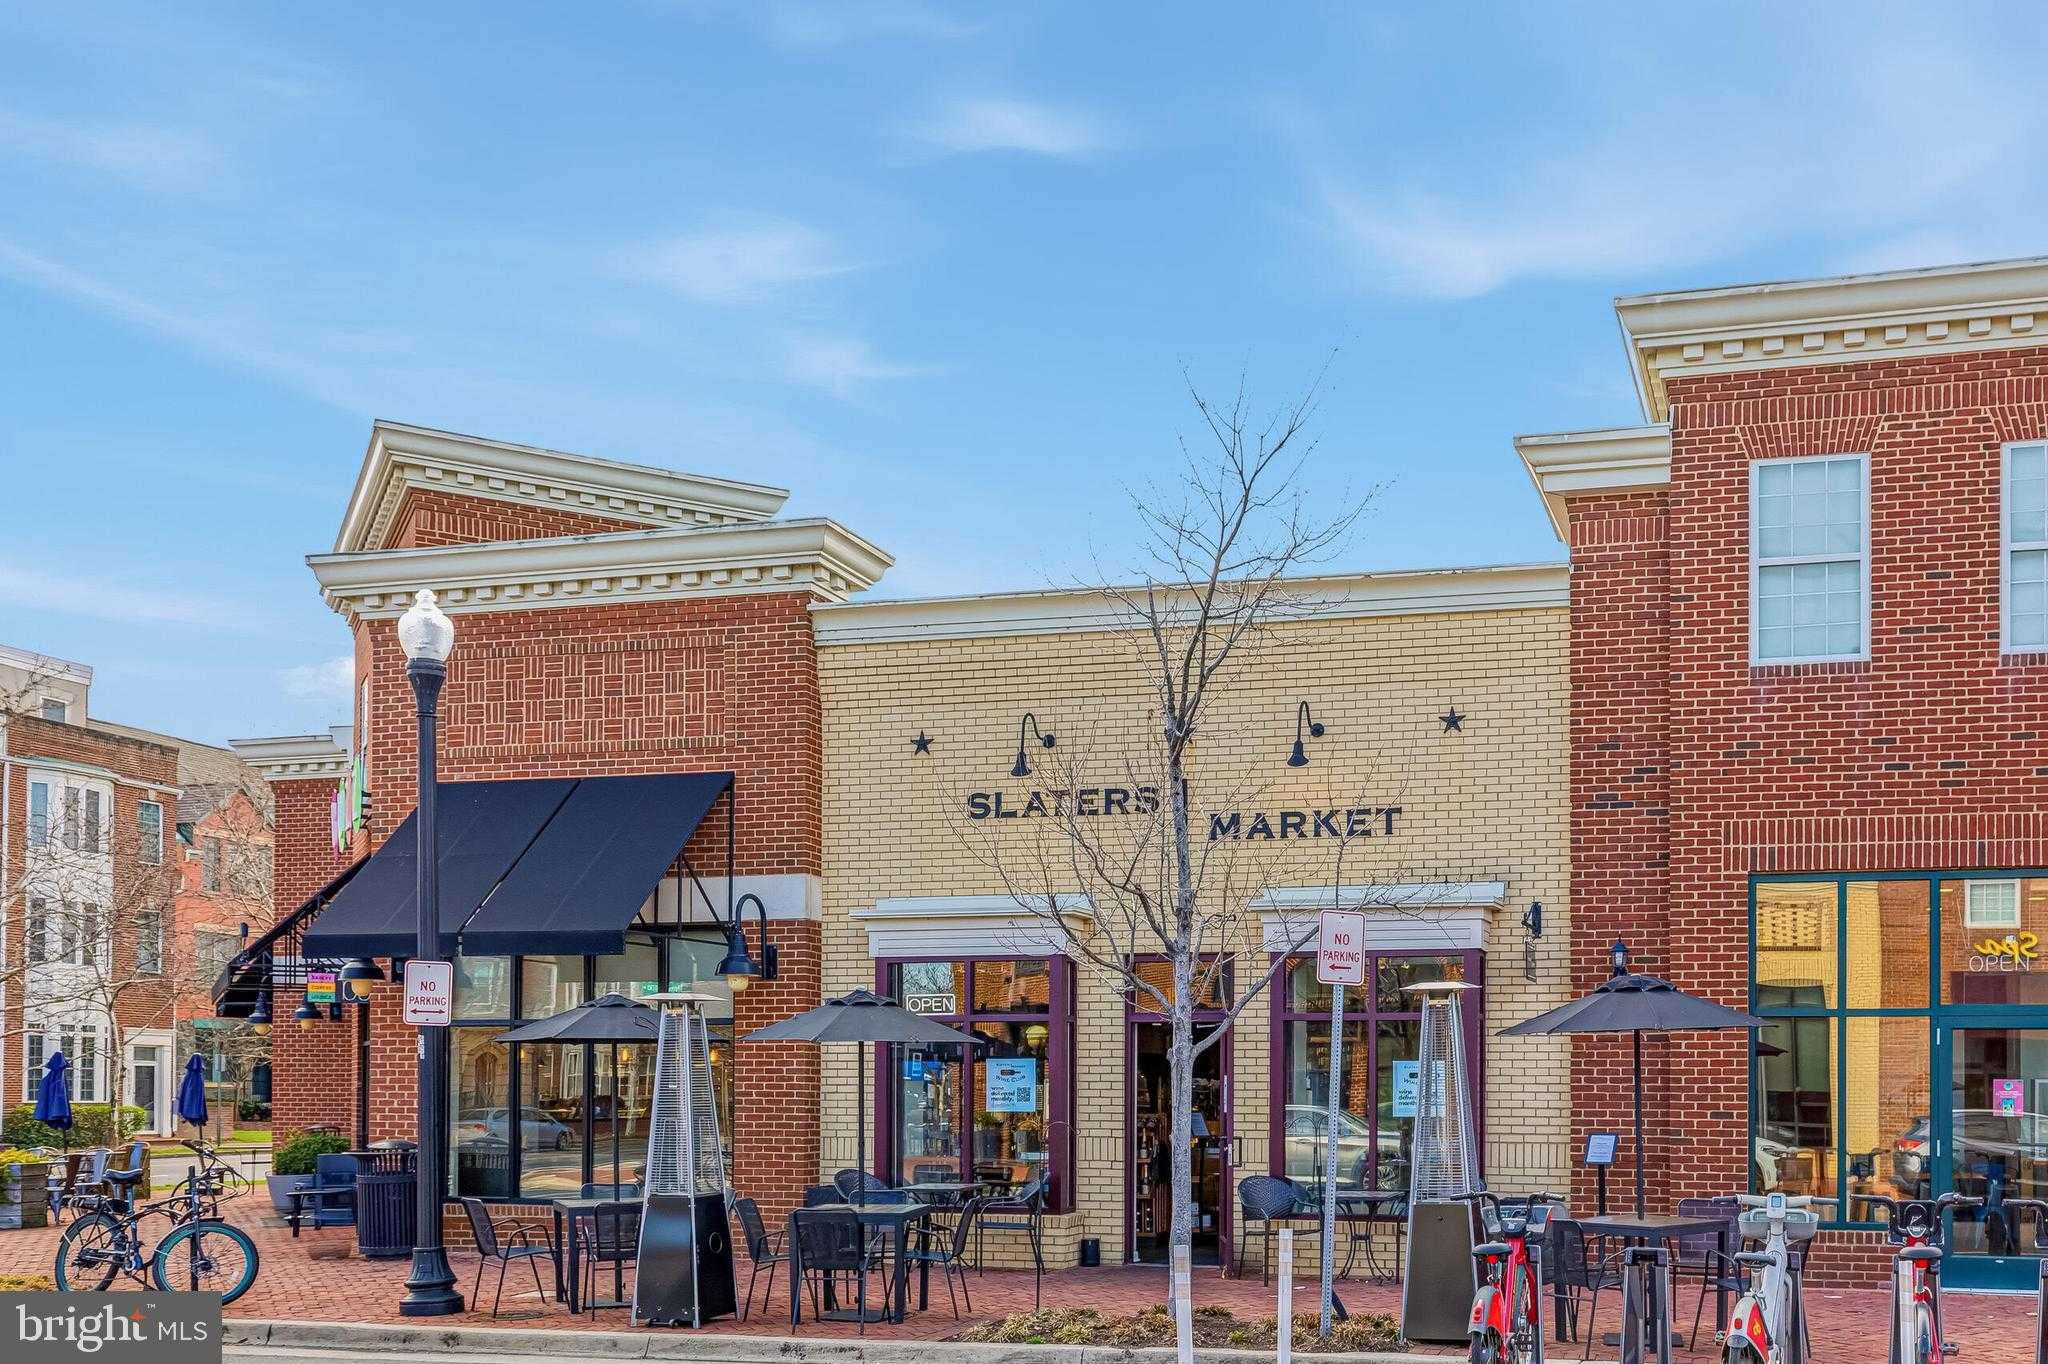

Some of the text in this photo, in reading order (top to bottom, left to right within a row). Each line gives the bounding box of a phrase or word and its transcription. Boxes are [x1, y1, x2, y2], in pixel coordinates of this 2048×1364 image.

[968, 787, 1160, 819] SLATERS
[1209, 807, 1402, 840] MARKET
[1335, 934, 1350, 945] NO
[1323, 950, 1360, 962] PARKING
[1969, 955, 2030, 972] OPEN
[420, 981, 436, 992] NO
[409, 996, 447, 1006] PARKING
[909, 998, 954, 1012] OPEN
